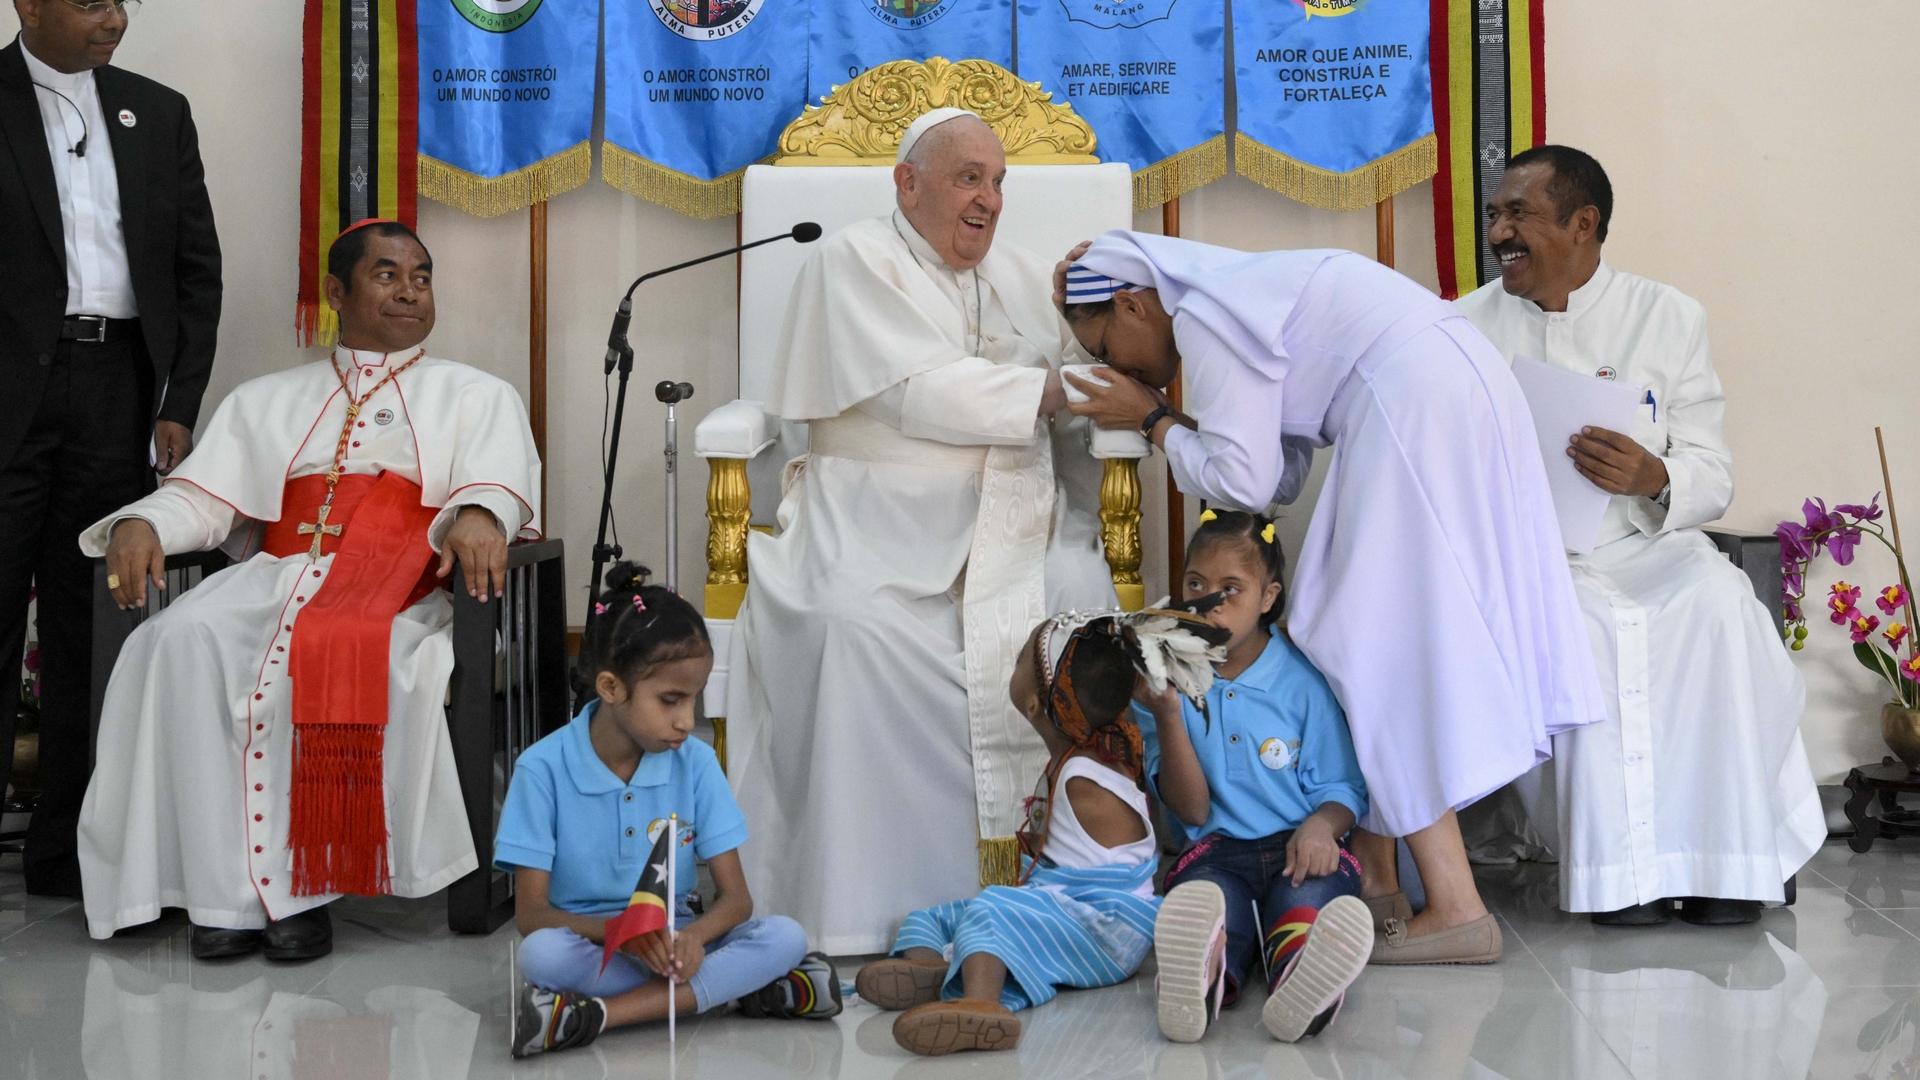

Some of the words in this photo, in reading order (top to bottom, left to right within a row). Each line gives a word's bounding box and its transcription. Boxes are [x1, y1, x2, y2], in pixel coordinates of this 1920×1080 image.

[470, 8, 523, 27] INDONESIA
[870, 5, 898, 25] ALMA
[910, 5, 947, 27] PUTERA
[1094, 4, 1144, 16] MALANG
[656, 6, 685, 34] ALMA
[708, 10, 755, 38] PUTERI
[1256, 49, 1307, 63] AMOR
[1312, 48, 1348, 64] QUE
[1353, 44, 1413, 60] ANIME,
[432, 69, 442, 83] O
[445, 68, 487, 83] AMOR
[491, 65, 557, 83] CONSTRÓI
[643, 69, 654, 83] O
[657, 69, 695, 83] AMOR
[698, 65, 770, 83] CONSTRÓI
[1061, 63, 1114, 78] AMARE,
[1118, 62, 1176, 77] SERVIRE
[1279, 63, 1375, 82] CONSTRÚA
[1379, 64, 1390, 78] E
[437, 88, 457, 102] UM
[461, 88, 511, 102] MUNDO
[515, 87, 550, 101] NOVO
[649, 89, 670, 103] UM
[674, 88, 720, 102] MUNDO
[724, 87, 764, 101] NOVO
[1068, 83, 1085, 97] ET
[1089, 81, 1170, 96] AEDIFICARE
[1284, 84, 1387, 102] FORTALEÇA
